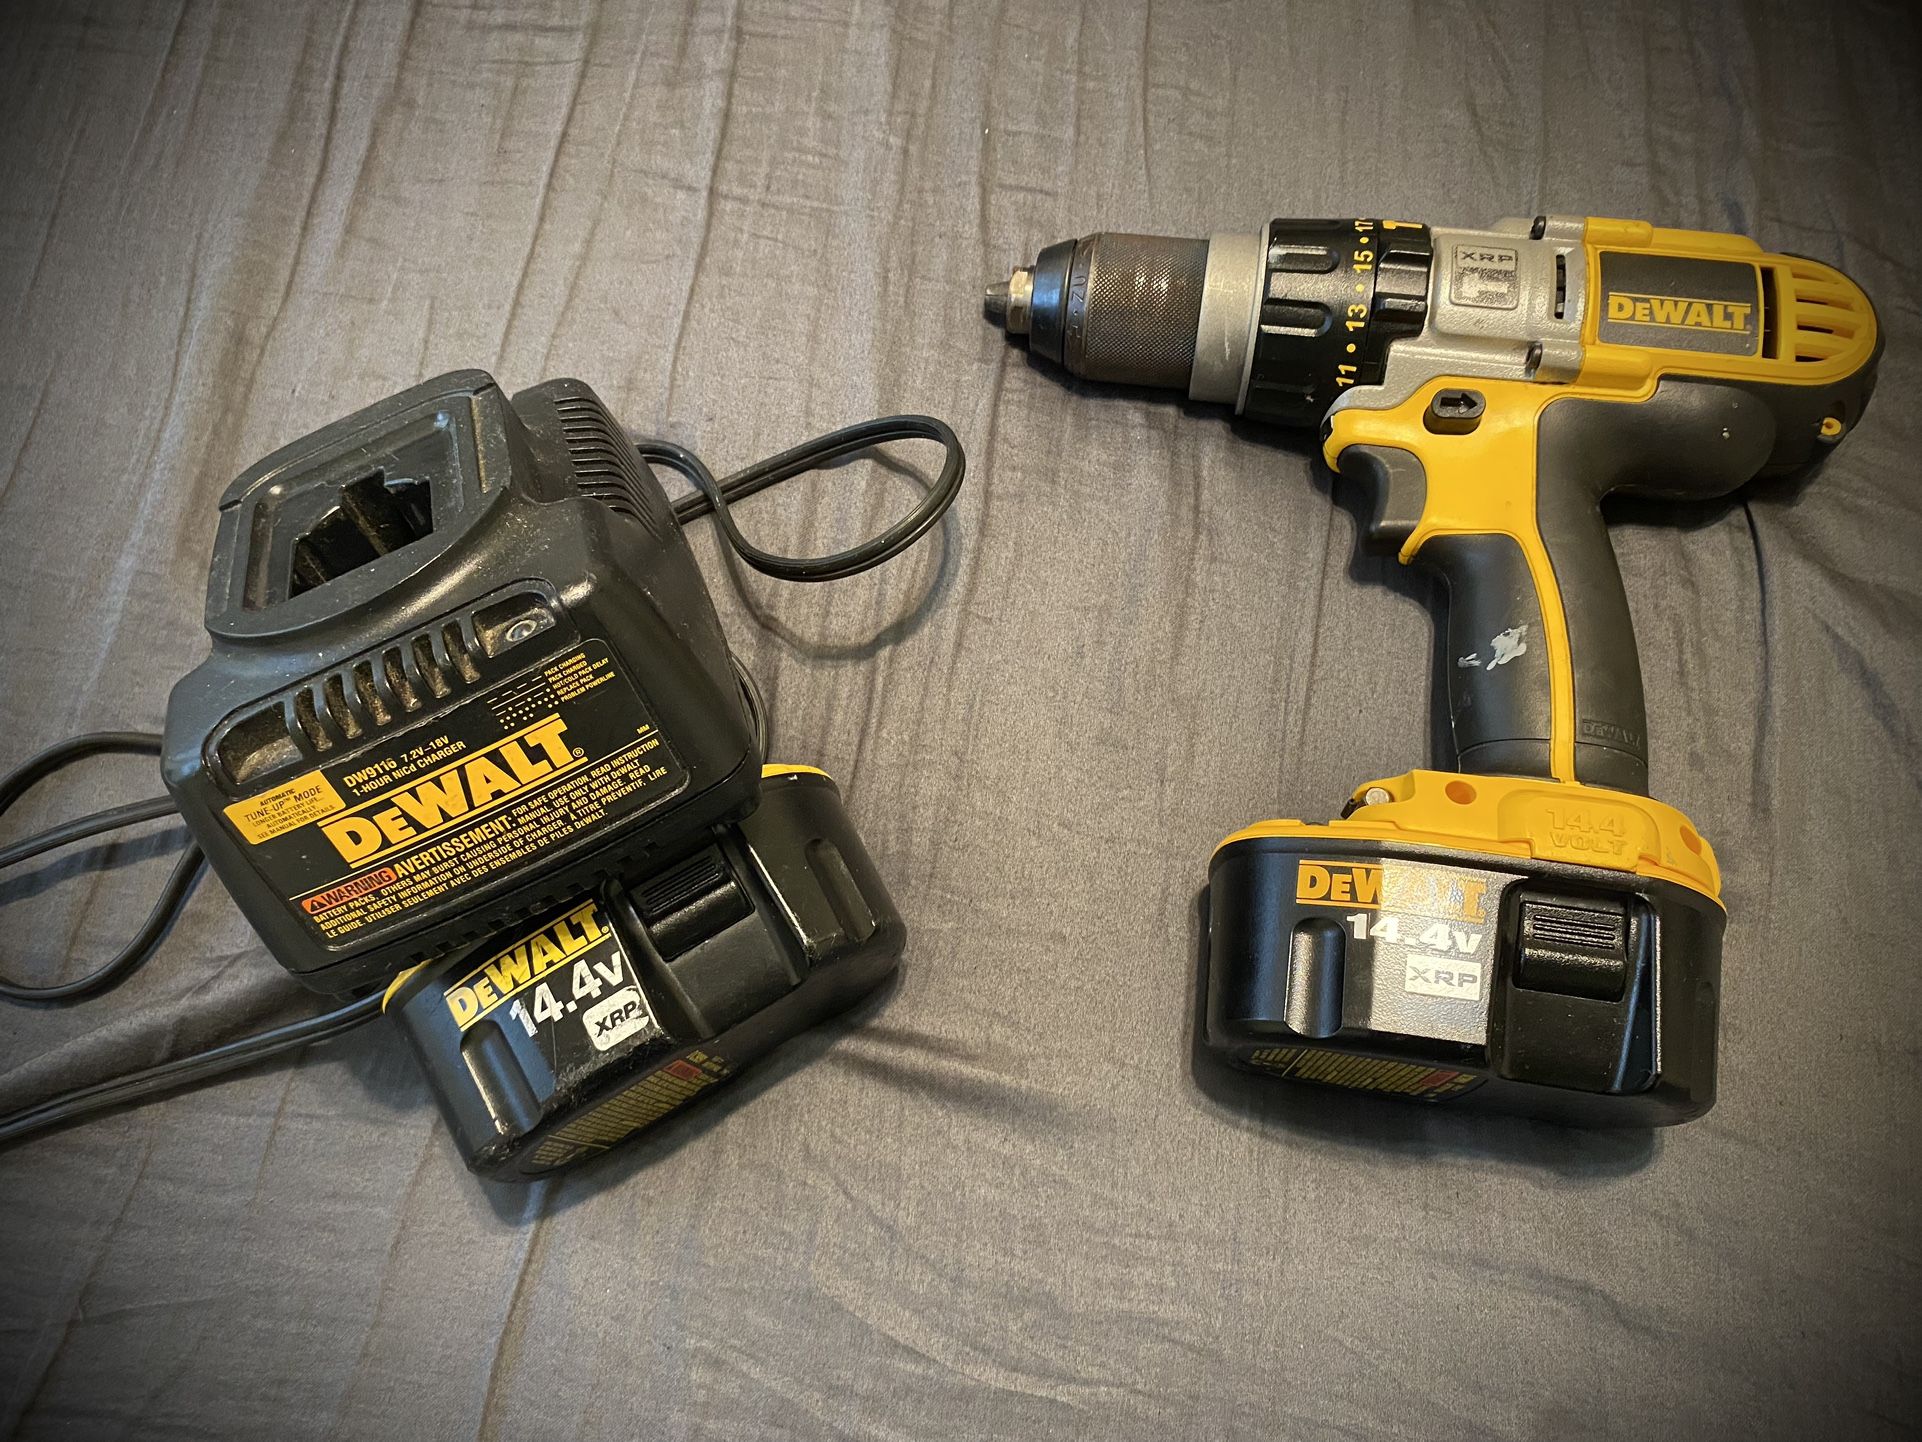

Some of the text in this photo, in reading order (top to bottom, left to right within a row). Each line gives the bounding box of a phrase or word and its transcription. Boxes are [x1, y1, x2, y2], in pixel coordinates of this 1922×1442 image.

[1352, 250, 1374, 273] 15
[1460, 251, 1513, 262] XRP
[1345, 303, 1368, 331] 13
[1608, 295, 1751, 330] DEWALT
[1336, 364, 1357, 387] 11
[544, 666, 559, 676] PACK
[548, 673, 563, 682] PACK
[578, 666, 593, 675] PACK
[592, 658, 609, 668] DELAY
[580, 674, 594, 683] PACK
[343, 757, 398, 787] DW9116
[352, 740, 466, 796] 1-HOUR NiCd CHARGER
[512, 738, 659, 816] FOR SAFE OPERATION, READ INSTRUCTION
[259, 788, 296, 806] AUTOMATIC
[293, 785, 323, 802] MODE
[322, 718, 574, 863] DEWALT
[553, 795, 570, 807] USE
[569, 785, 590, 799] ONLY
[589, 775, 611, 789] WITH
[1546, 808, 1626, 837] 14.4
[313, 905, 348, 922] BATTERY
[380, 878, 413, 895] OTHERS
[413, 869, 434, 881] MAY
[432, 857, 460, 873] BURST
[460, 840, 497, 861] CAUSING
[497, 820, 540, 844] PERSONAL
[540, 805, 570, 823] INJURY
[570, 796, 589, 809] AND
[629, 764, 651, 779] READ
[320, 907, 367, 930] ADDITIONAL
[367, 895, 398, 911] SAFETY
[398, 871, 453, 898] INFORMATION
[453, 865, 466, 874] ON
[466, 844, 513, 869] UNDERSIDE
[513, 838, 525, 847] OF
[577, 801, 601, 816] TITRE
[648, 767, 667, 780] LIRE
[1550, 831, 1628, 855] VOLT
[321, 813, 516, 905] WARNING AVERTISSEMENT:
[365, 903, 402, 922] UTILISER
[402, 883, 449, 907] SEULEMENT
[449, 873, 471, 886] AVEC
[471, 865, 489, 876] DES
[489, 842, 537, 868] ENSEMBLES
[537, 837, 549, 846] DE
[550, 825, 574, 840] PILES
[445, 903, 602, 1029] DEWALT
[1408, 966, 1478, 988] XRP
[594, 1000, 638, 1037] XRP
